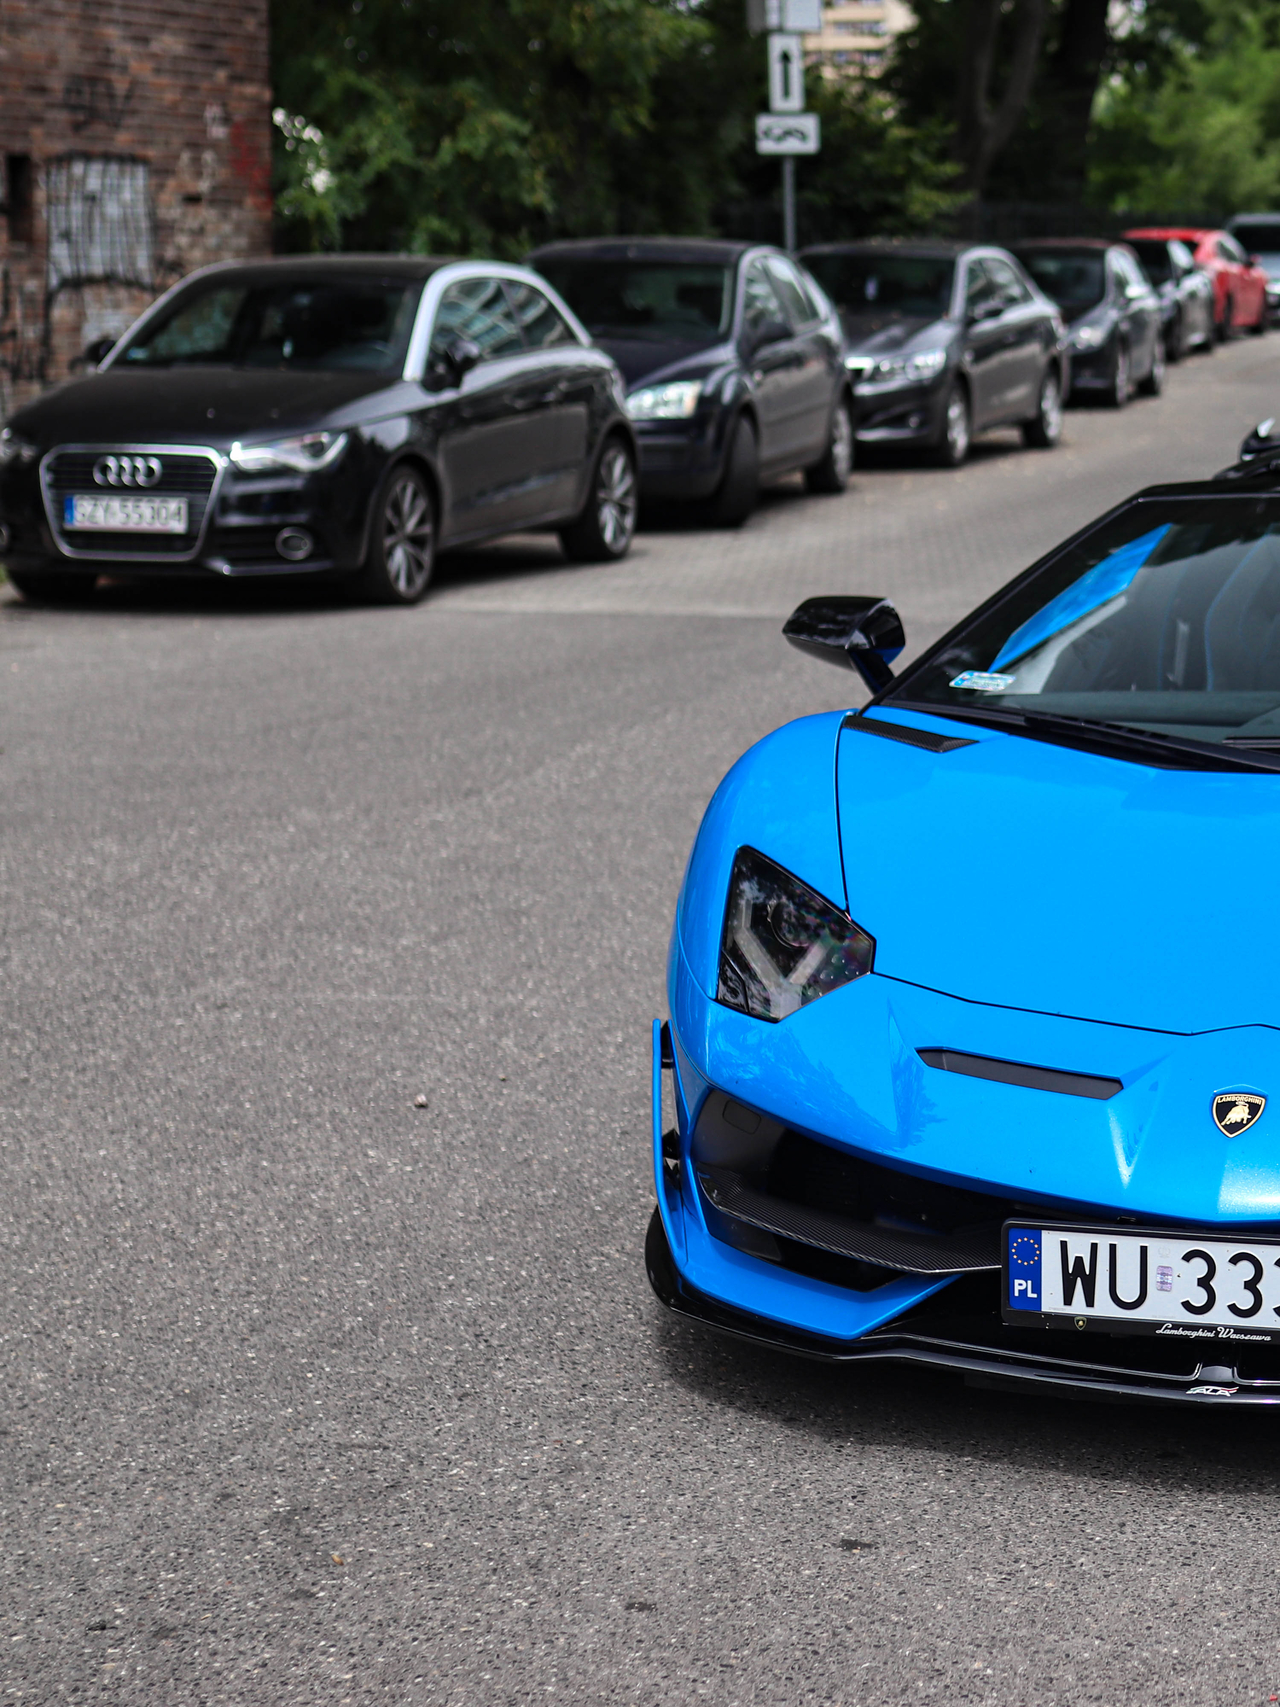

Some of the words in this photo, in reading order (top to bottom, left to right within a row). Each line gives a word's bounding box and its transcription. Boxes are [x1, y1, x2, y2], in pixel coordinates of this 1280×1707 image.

[1217, 1096, 1262, 1105] LAMBORGHINI
[1059, 1239, 1149, 1311] WU
[1014, 1279, 1038, 1299] PL
[1155, 1323, 1217, 1339] Lamborghini
[1217, 1326, 1272, 1342] Warszawa
